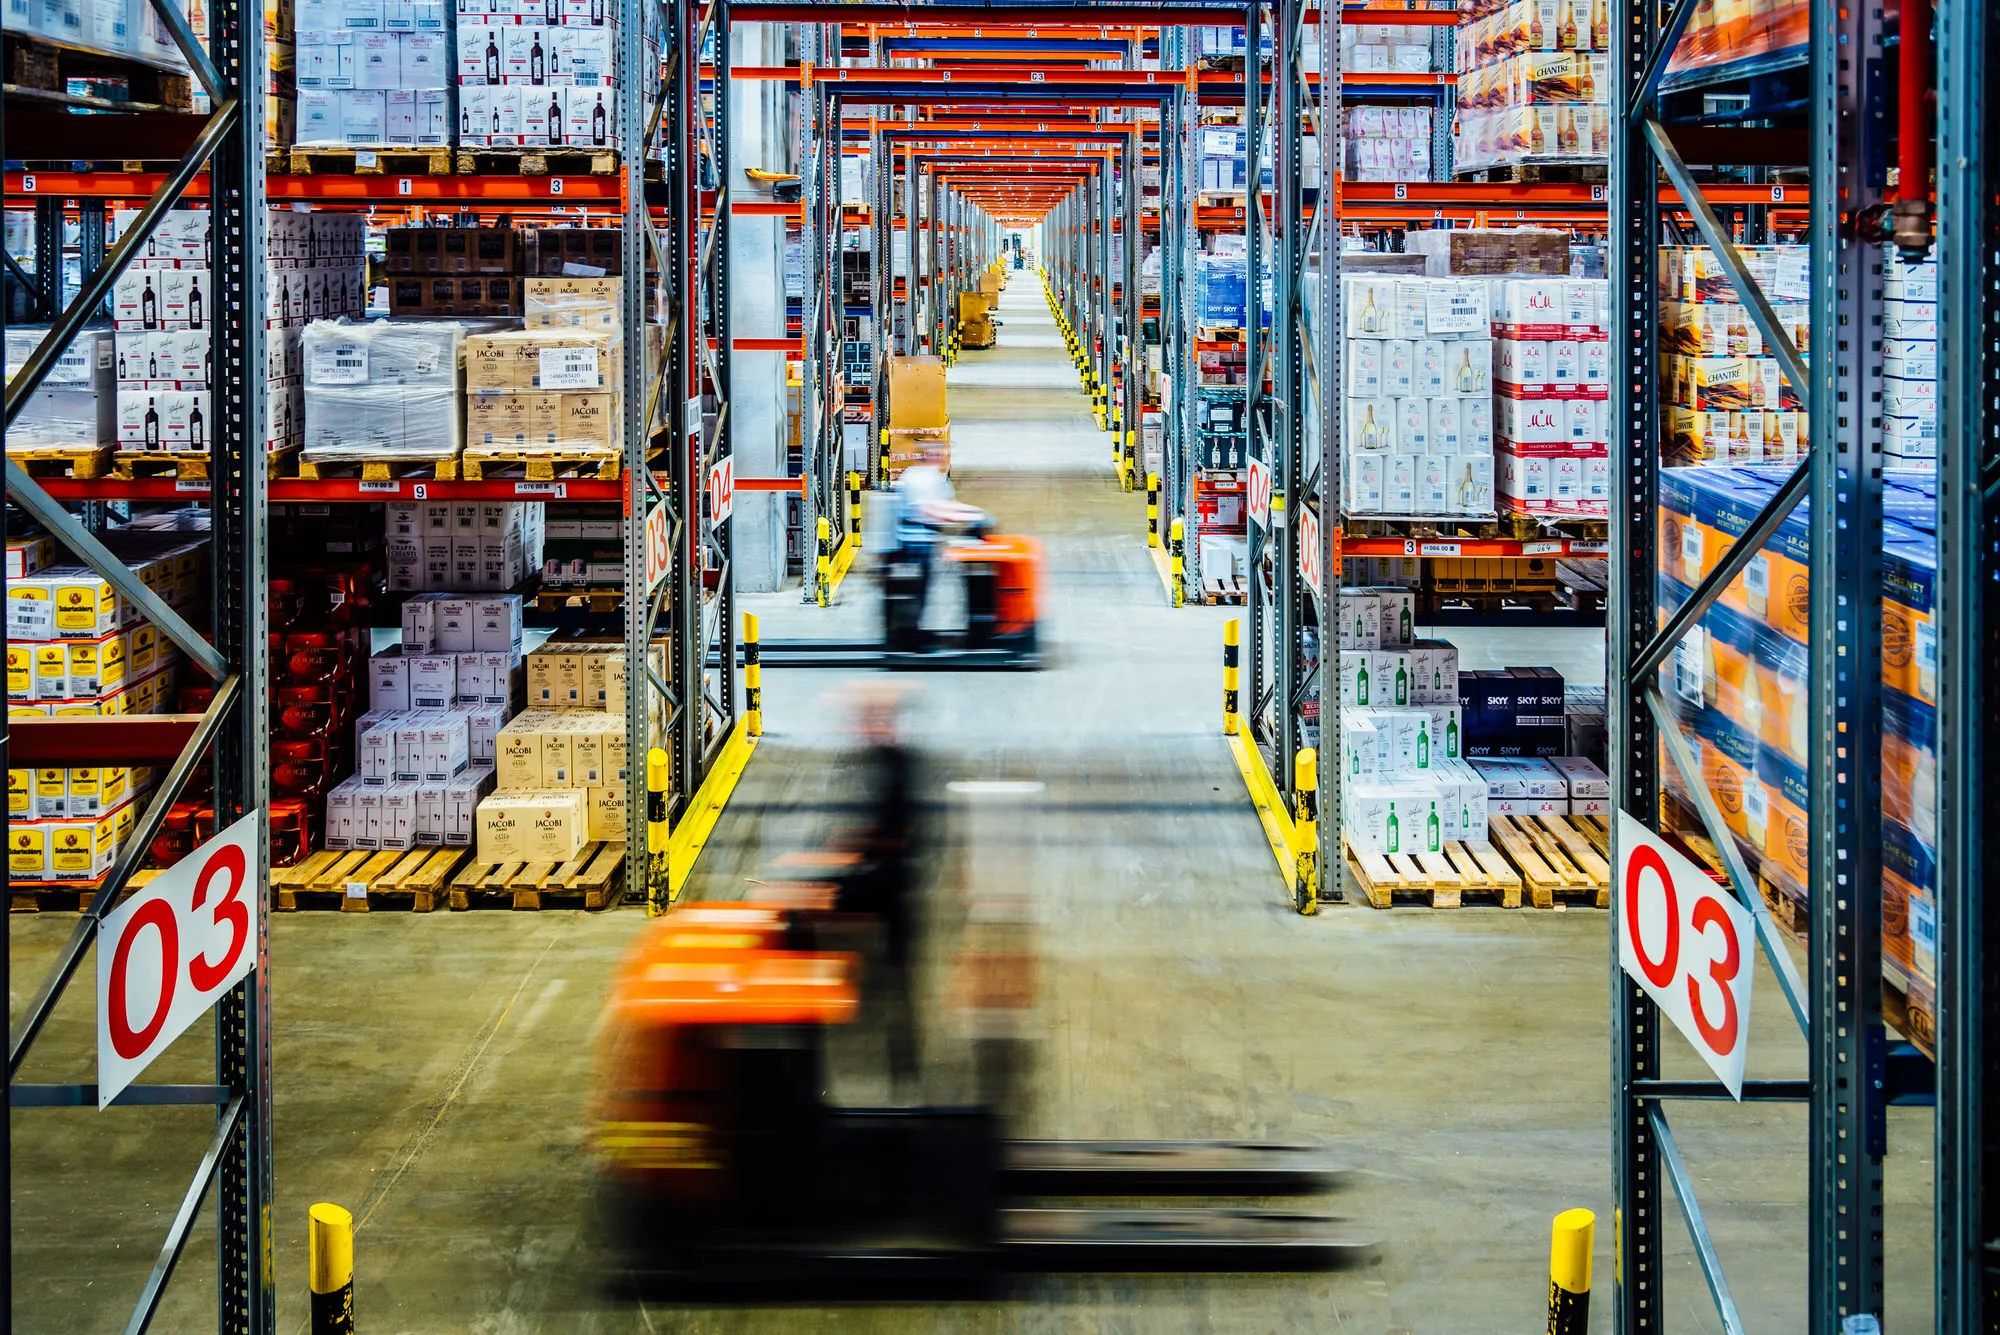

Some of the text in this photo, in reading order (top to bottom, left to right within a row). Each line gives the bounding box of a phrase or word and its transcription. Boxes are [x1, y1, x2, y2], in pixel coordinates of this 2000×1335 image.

[840, 71, 846, 79] 9
[1148, 74, 1154, 82] 1
[1236, 74, 1242, 82] 9
[1438, 75, 1444, 83] 3
[974, 122, 979, 130] 2
[25, 177, 34, 189] 5
[402, 181, 410, 193] 1
[553, 181, 561, 192] 3
[1397, 185, 1405, 197] 5
[1593, 187, 1602, 198] B
[1774, 188, 1782, 200] 9
[1436, 210, 1441, 218] 2
[476, 350, 504, 358] JACOBI
[572, 407, 599, 416] JACOBI
[416, 486, 425, 498] 9
[558, 484, 564, 496] 1
[711, 461, 731, 522] 04
[1249, 463, 1269, 524] 04
[647, 508, 669, 584] 03
[1301, 512, 1319, 585] 03
[1406, 541, 1414, 552] 3
[1537, 544, 1551, 553] 064
[1887, 573, 1925, 593] CHENET
[291, 656, 324, 664] ROUGE
[1487, 696, 1509, 705] SKYY
[1517, 696, 1538, 705] SKYY
[1541, 696, 1562, 705] SKYY
[284, 710, 316, 718] ROUGE
[488, 820, 515, 829] JACOBI
[535, 820, 562, 828] JACOBI
[108, 844, 249, 1060] 03
[1626, 844, 1740, 1056] 03
